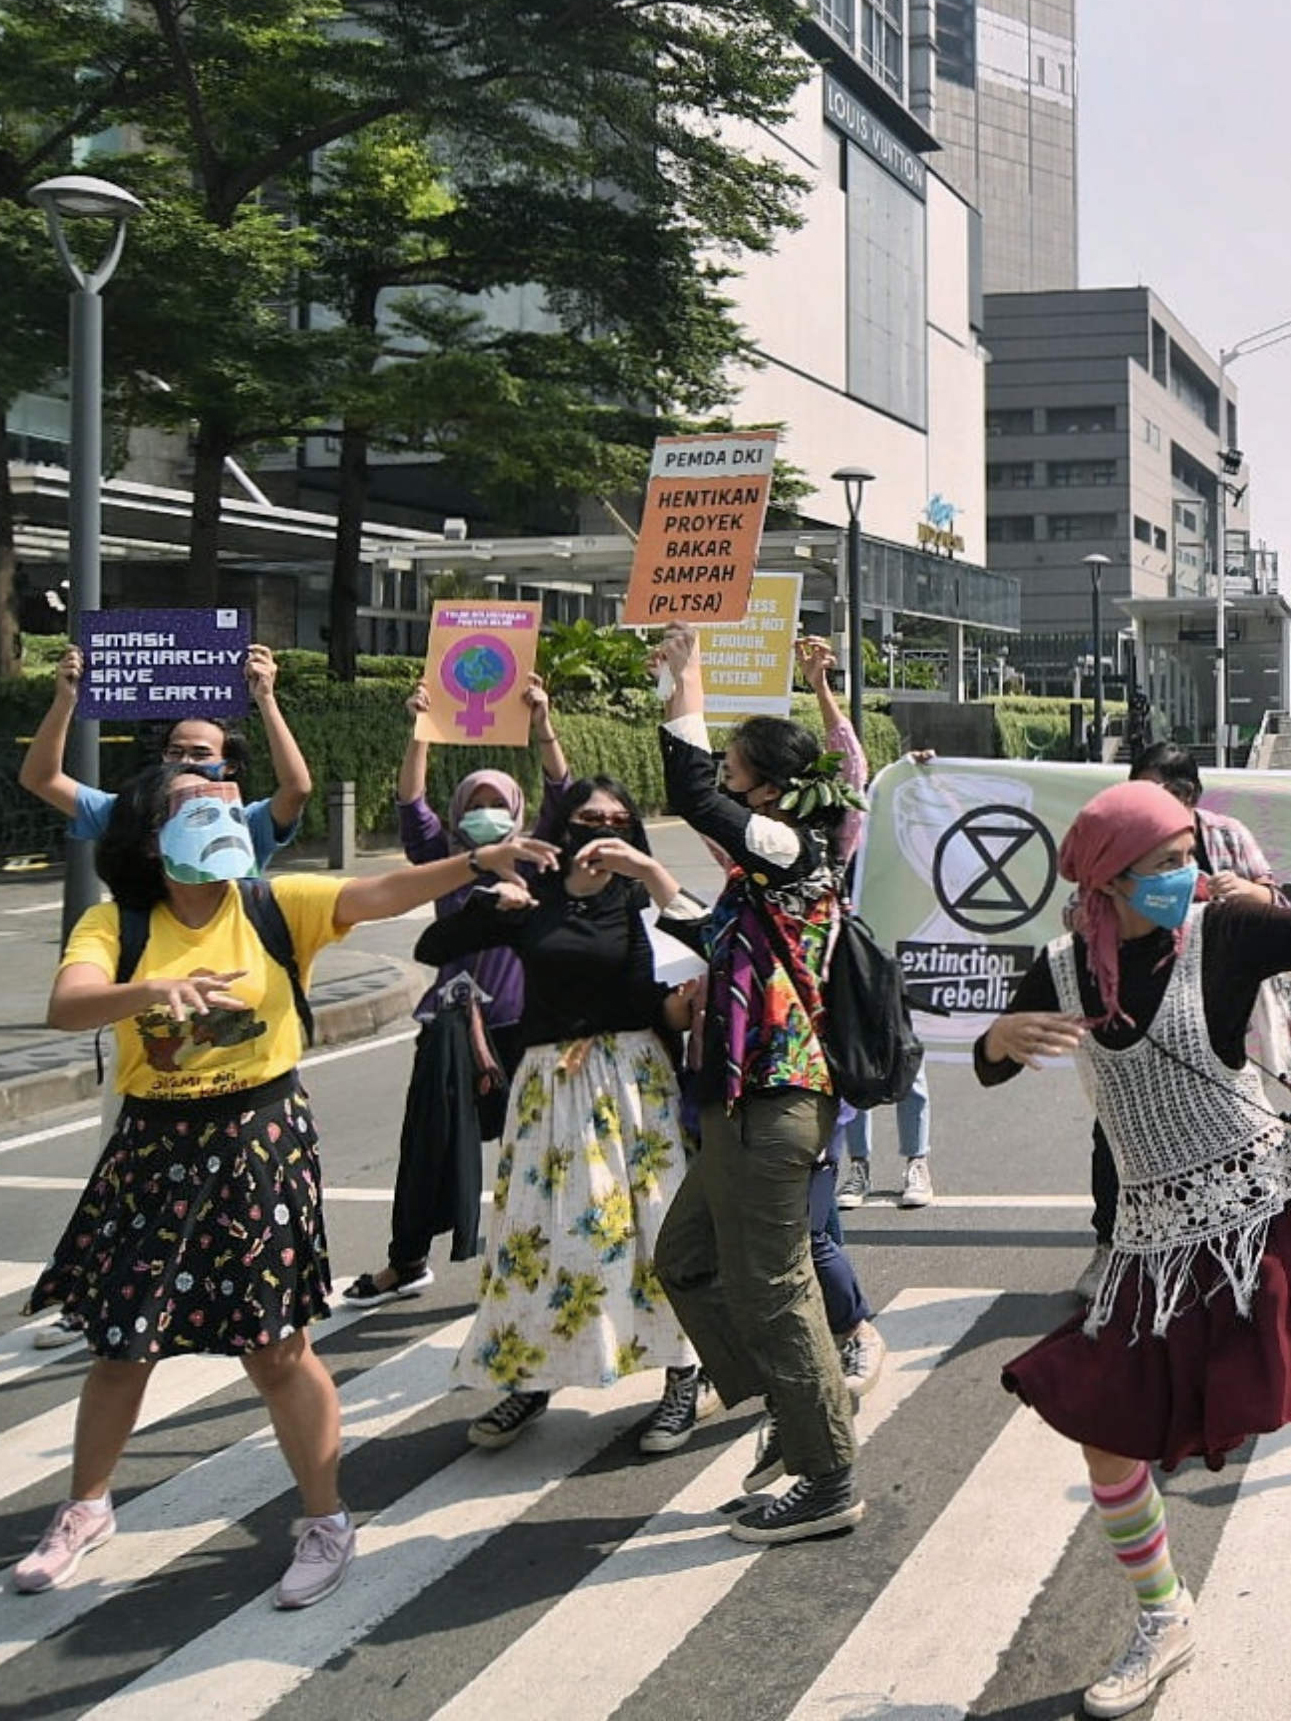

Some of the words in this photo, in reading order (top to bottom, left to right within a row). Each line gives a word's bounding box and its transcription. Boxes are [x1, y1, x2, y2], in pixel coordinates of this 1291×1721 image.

[828, 84, 868, 139] LOUIS
[871, 126, 923, 189] VUITTON
[665, 449, 727, 468] PEMDA
[732, 448, 763, 465] DKI
[658, 487, 759, 508] HENTIKAN
[663, 514, 743, 534] PROYEK
[666, 540, 731, 558] BAKAR
[652, 564, 735, 584] SAMPAH
[649, 591, 722, 615] (PLTSA)
[91, 633, 175, 647] SMASH
[91, 651, 242, 665] PATRIARCHY
[91, 668, 153, 683] SAVE
[90, 687, 138, 701] THE
[149, 686, 232, 700] EARTH
[901, 945, 1015, 975] extinction
[931, 976, 1017, 1009] rebelli
